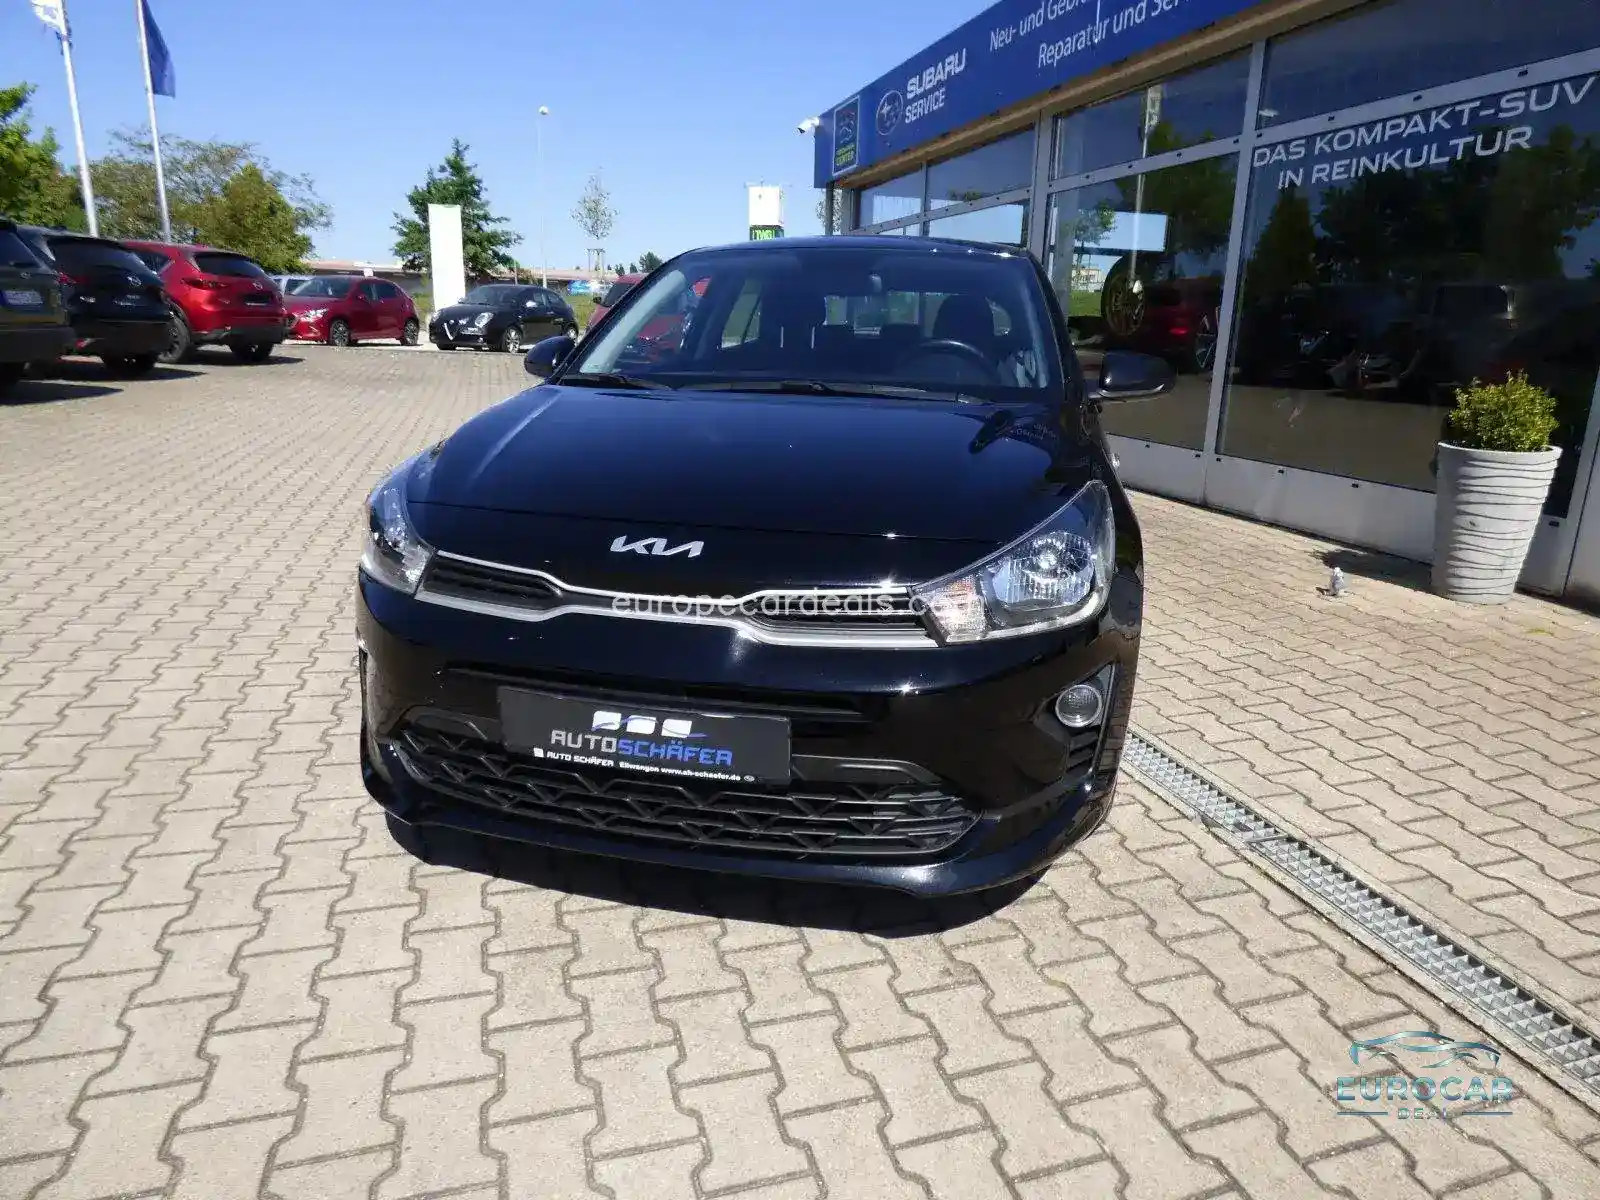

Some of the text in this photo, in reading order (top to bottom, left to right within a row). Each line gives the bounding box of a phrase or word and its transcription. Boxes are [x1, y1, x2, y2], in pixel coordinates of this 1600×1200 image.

[990, 26, 1017, 51] Neu-
[1019, 7, 1044, 36] und
[1037, 17, 1110, 68] Reparatur
[1113, 0, 1147, 34] und
[906, 48, 967, 100] SUBARU
[904, 87, 946, 124] SERVICE
[1253, 76, 1596, 168] DAS KOMPAKT-SUV
[1277, 126, 1532, 191] IN REINKULTUR
[546, 751, 572, 762] AUTO
[573, 756, 614, 768] SCHÄFER
